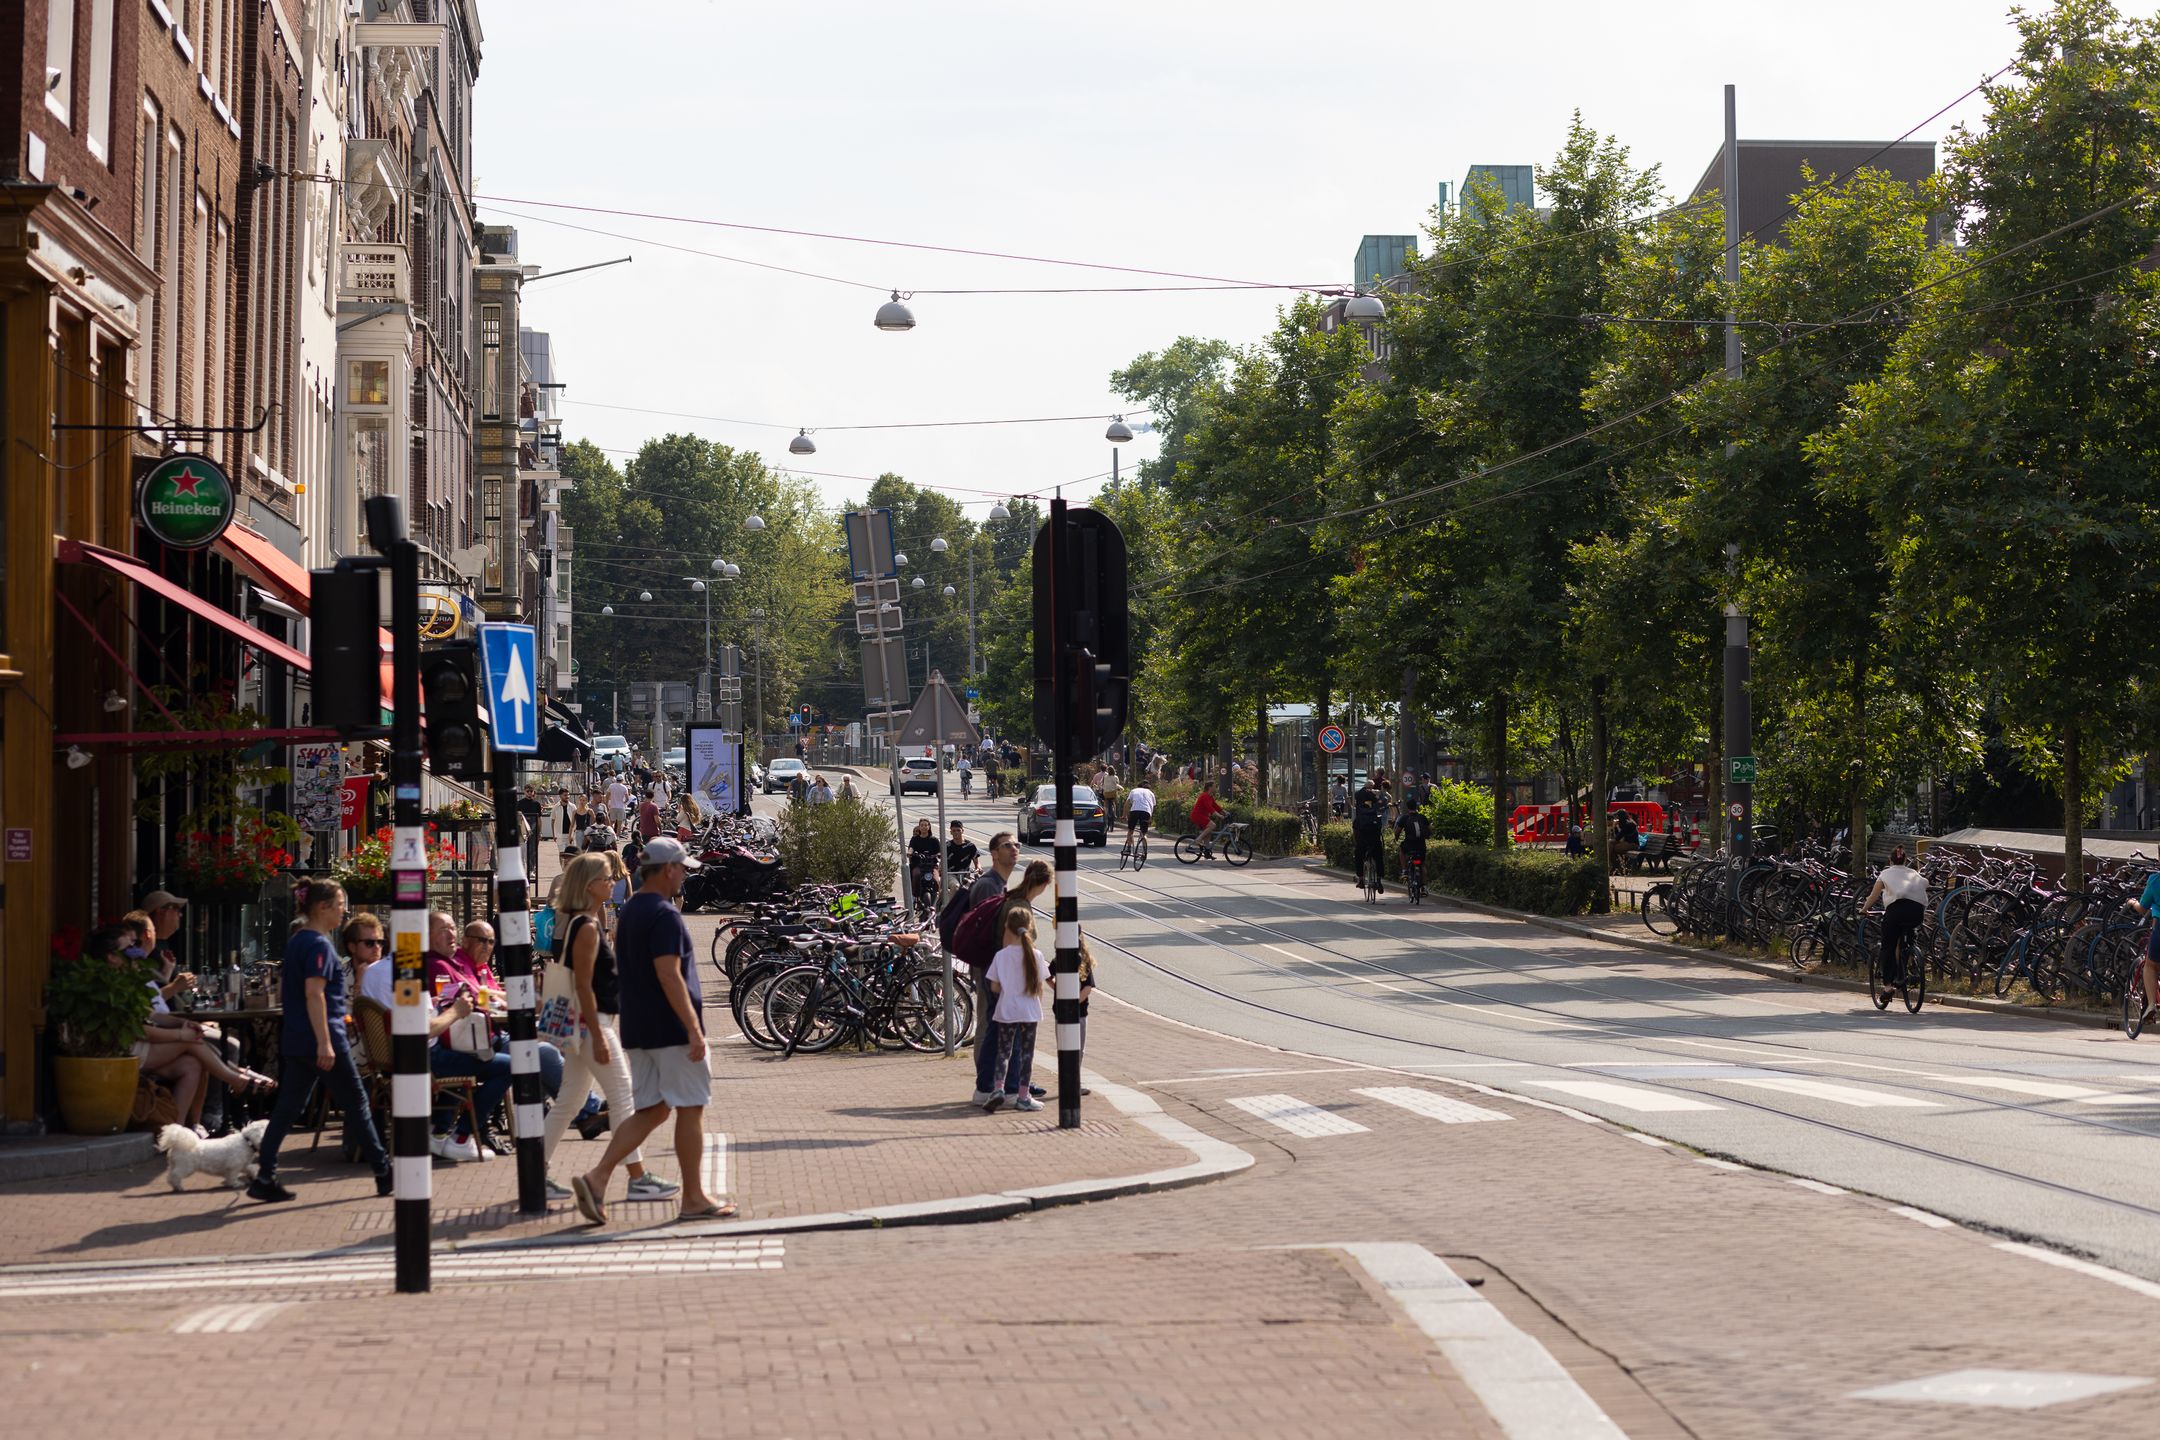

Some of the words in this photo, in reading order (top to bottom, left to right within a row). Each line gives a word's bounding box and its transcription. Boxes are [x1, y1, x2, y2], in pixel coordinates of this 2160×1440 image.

[151, 502, 221, 516] Heineken
[1733, 761, 1741, 773] P
[1732, 806, 1742, 814] 30
